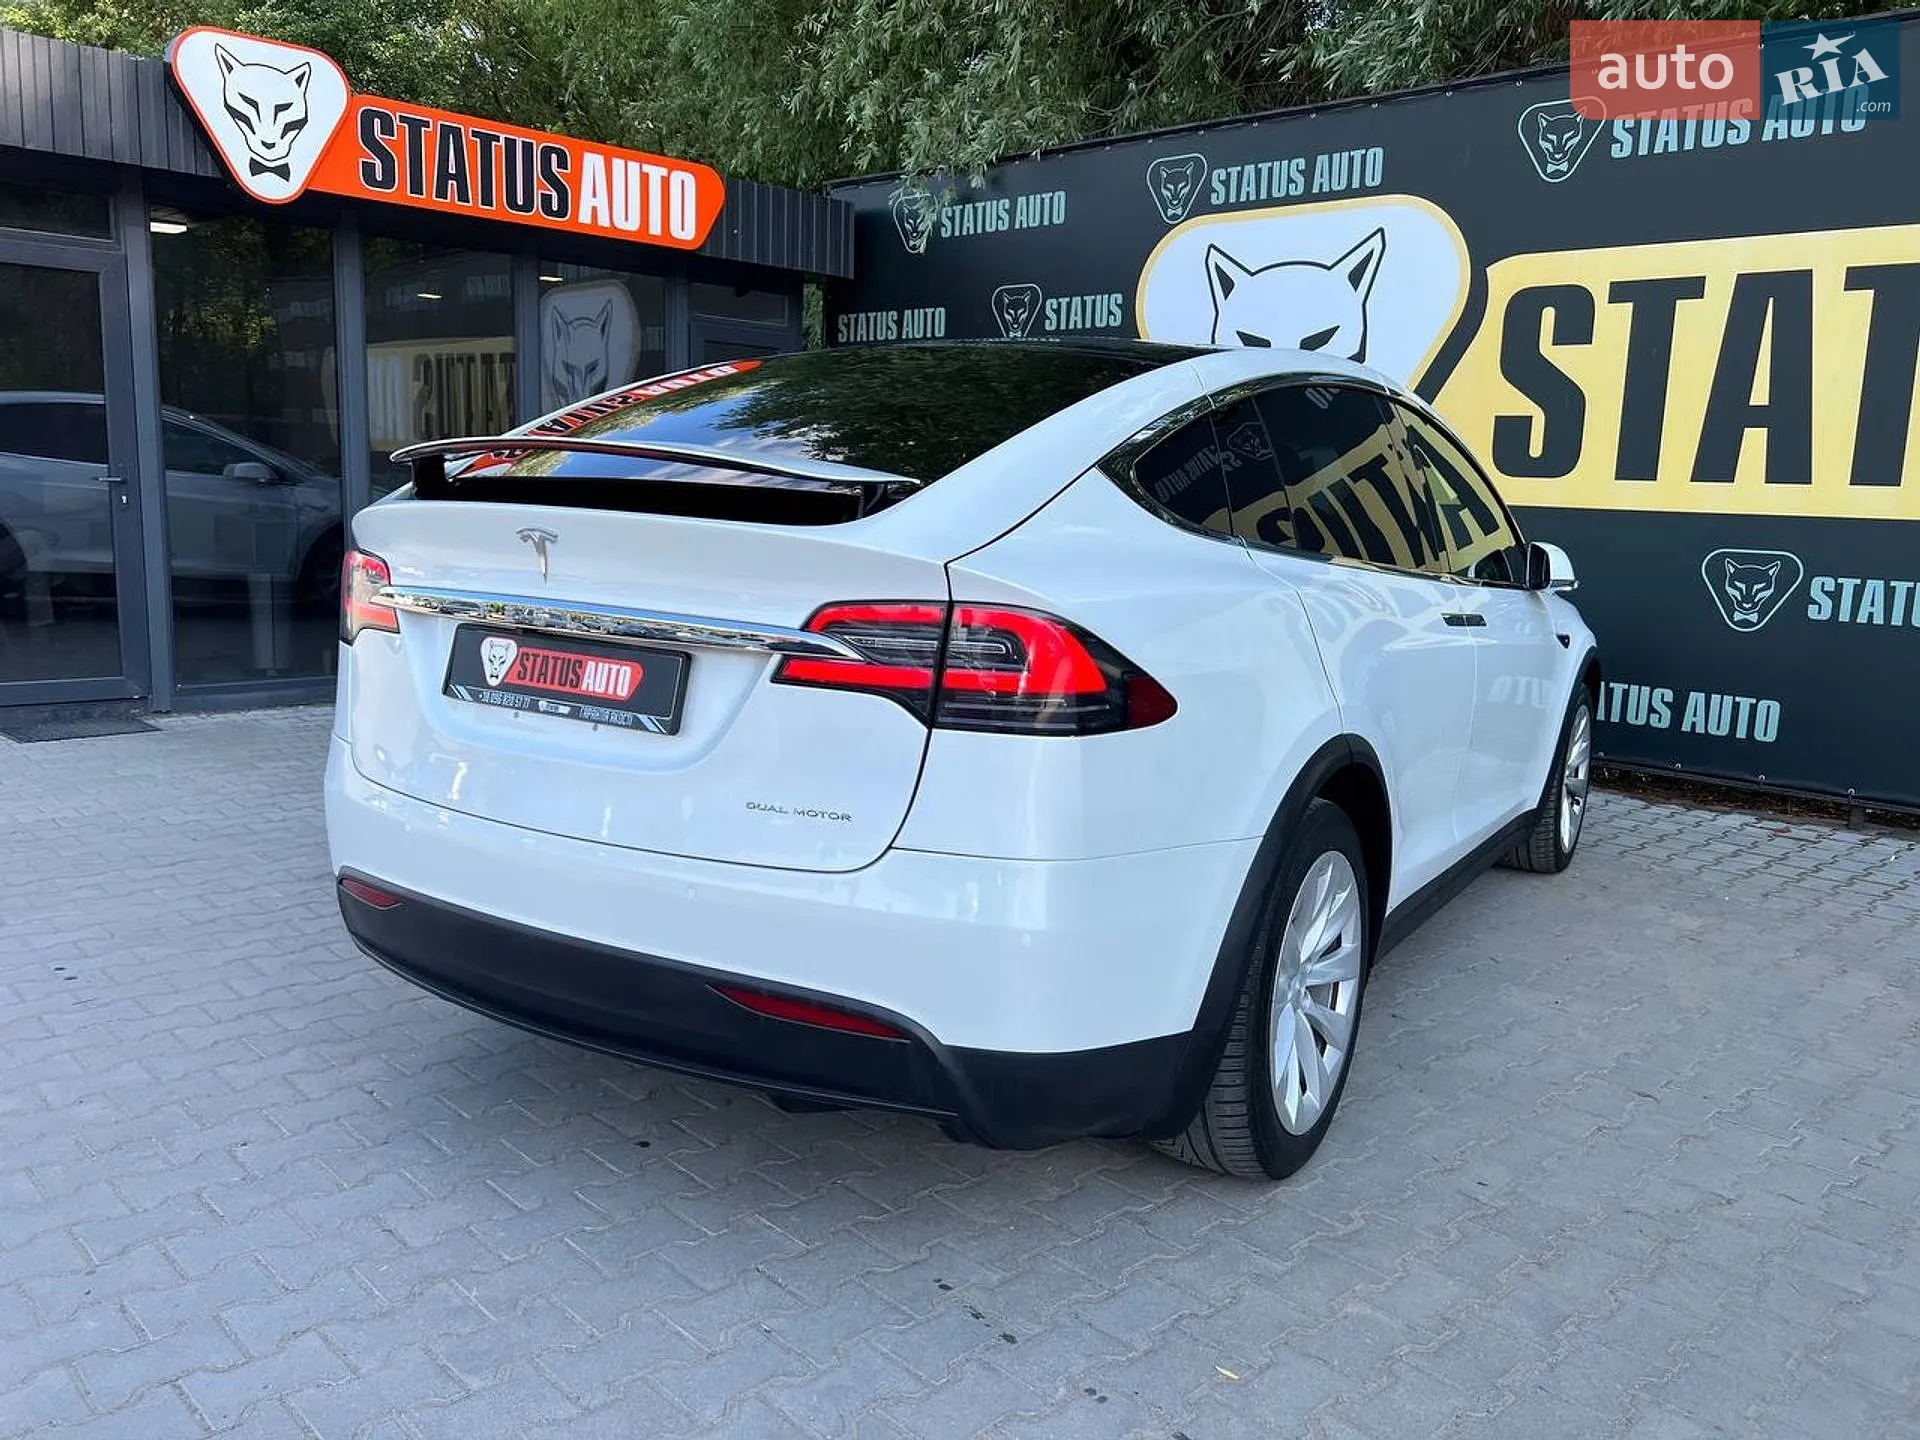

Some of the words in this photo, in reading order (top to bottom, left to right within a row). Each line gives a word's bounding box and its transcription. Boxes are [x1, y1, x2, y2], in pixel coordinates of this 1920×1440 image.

[1610, 98, 1754, 159] STATUS
[358, 107, 571, 220] STATUS
[577, 153, 697, 240] AUTO
[1210, 157, 1305, 205] STATUS
[1312, 147, 1384, 194] AUTO
[940, 197, 1009, 239] STATUS
[1014, 190, 1067, 230] AUTO
[837, 310, 897, 343] STATUS
[902, 306, 947, 338] AUTO
[1045, 293, 1123, 332] STATUS
[517, 651, 583, 688] STATUS
[581, 661, 632, 698] AUTO
[1680, 691, 1781, 742] AUTO
[745, 801, 789, 814] DUAL
[793, 808, 852, 821] MOTOR
